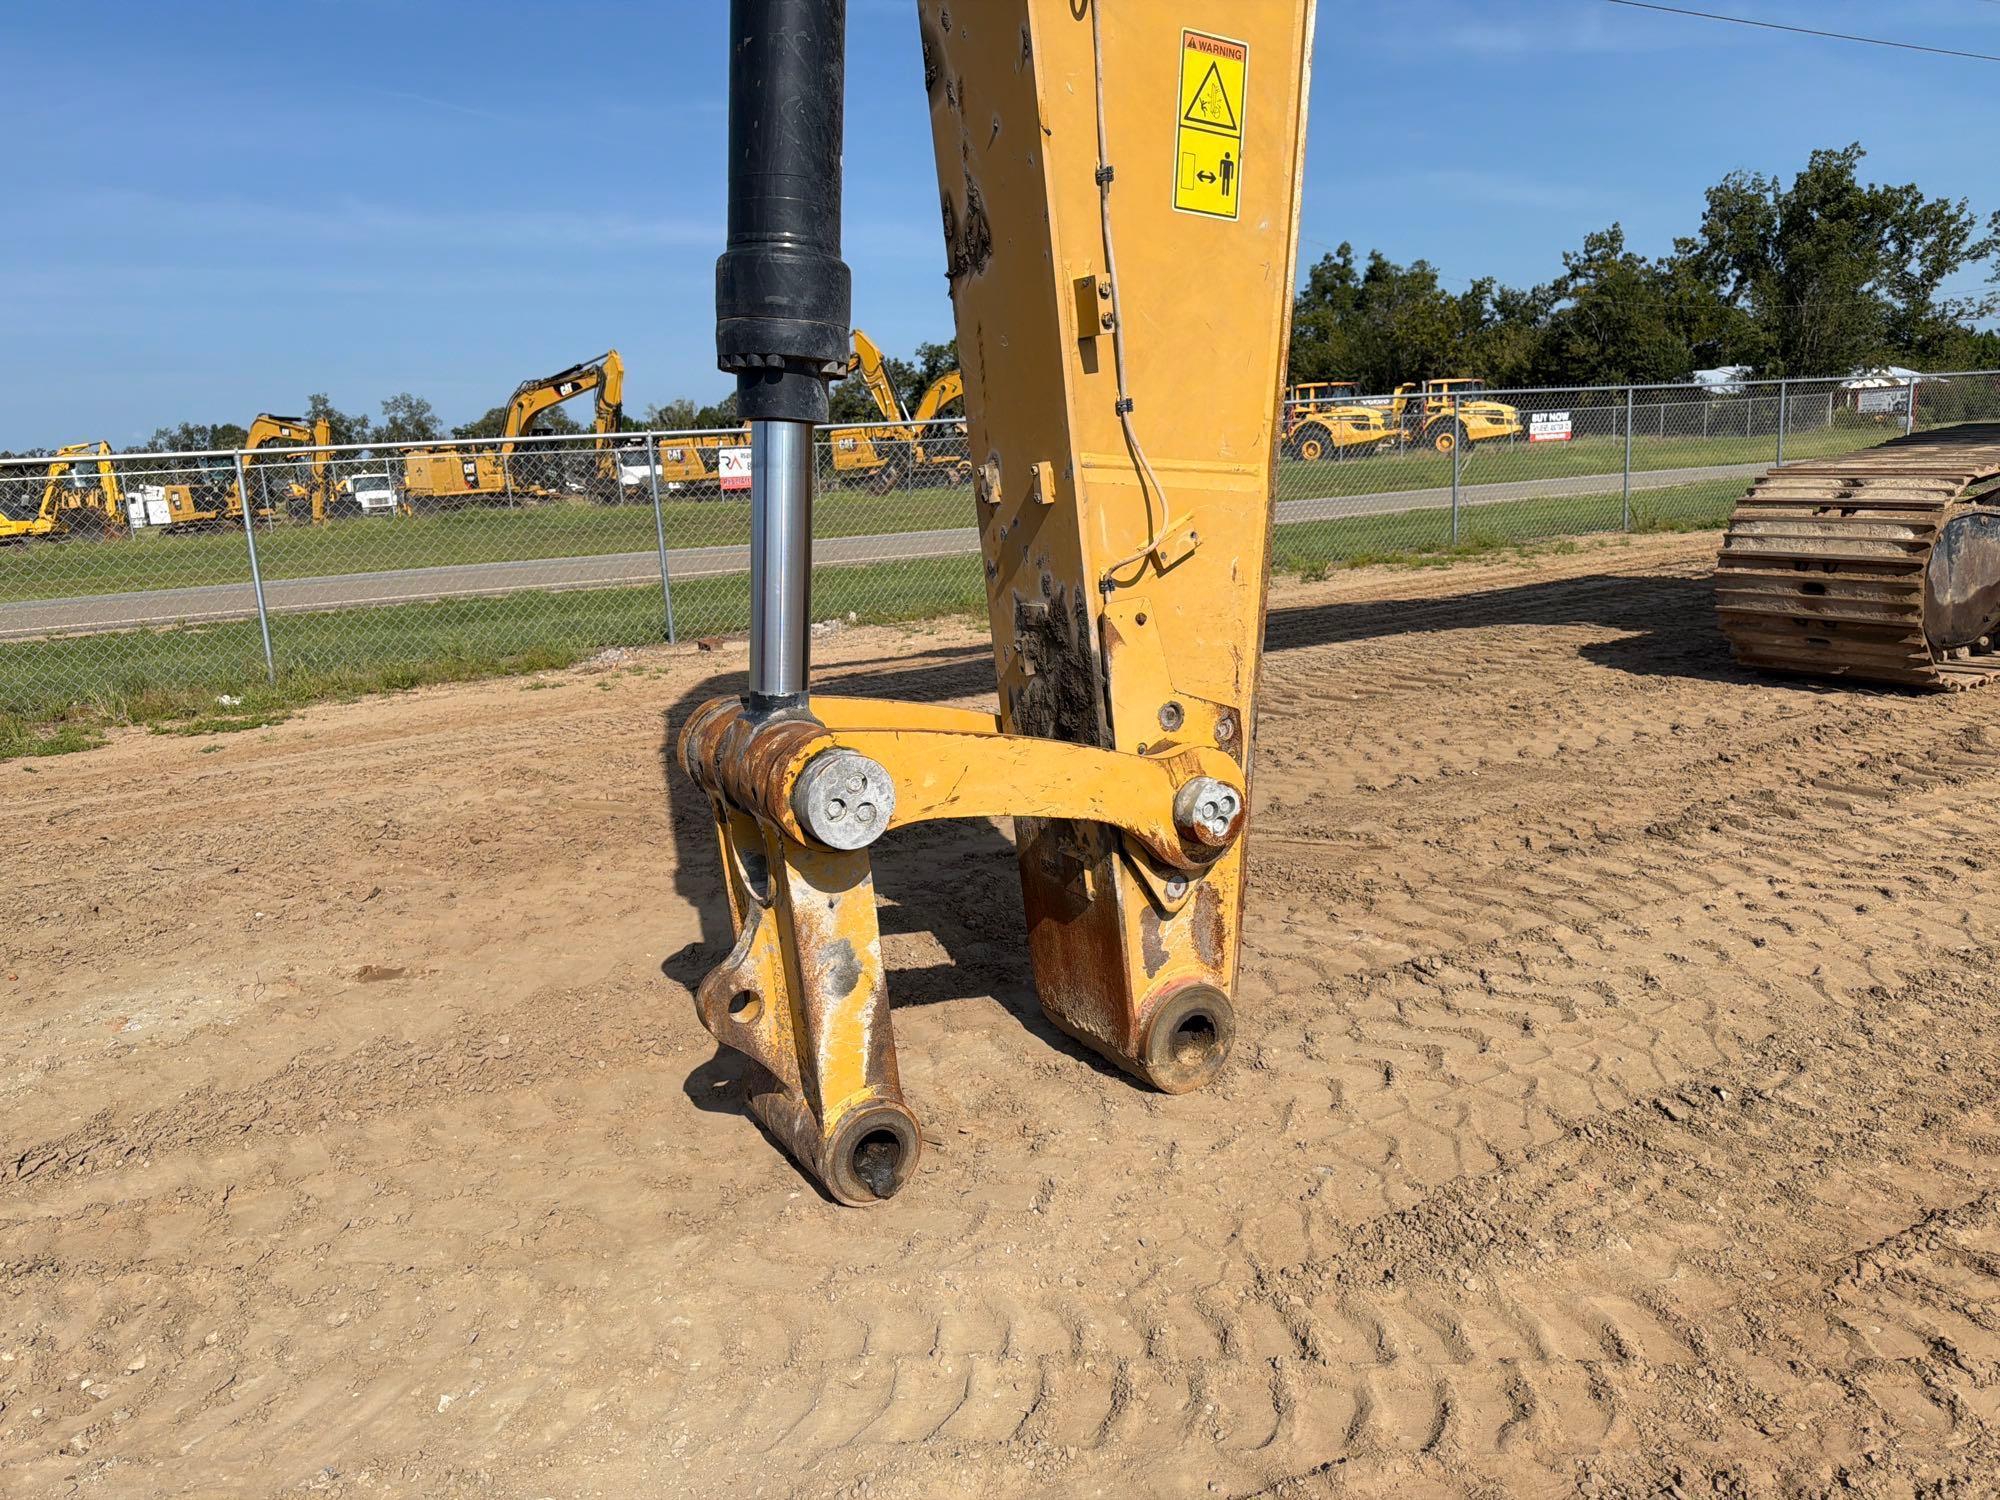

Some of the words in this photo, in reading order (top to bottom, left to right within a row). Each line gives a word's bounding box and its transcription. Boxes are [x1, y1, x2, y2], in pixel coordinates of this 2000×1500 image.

[1198, 40, 1242, 60] WARNING
[560, 382, 573, 396] CAT
[1532, 413, 1547, 422] BUY
[1549, 412, 1569, 422] NOW
[839, 439, 854, 450] CAT
[667, 449, 682, 461] CAT
[463, 463, 475, 474] CAT
